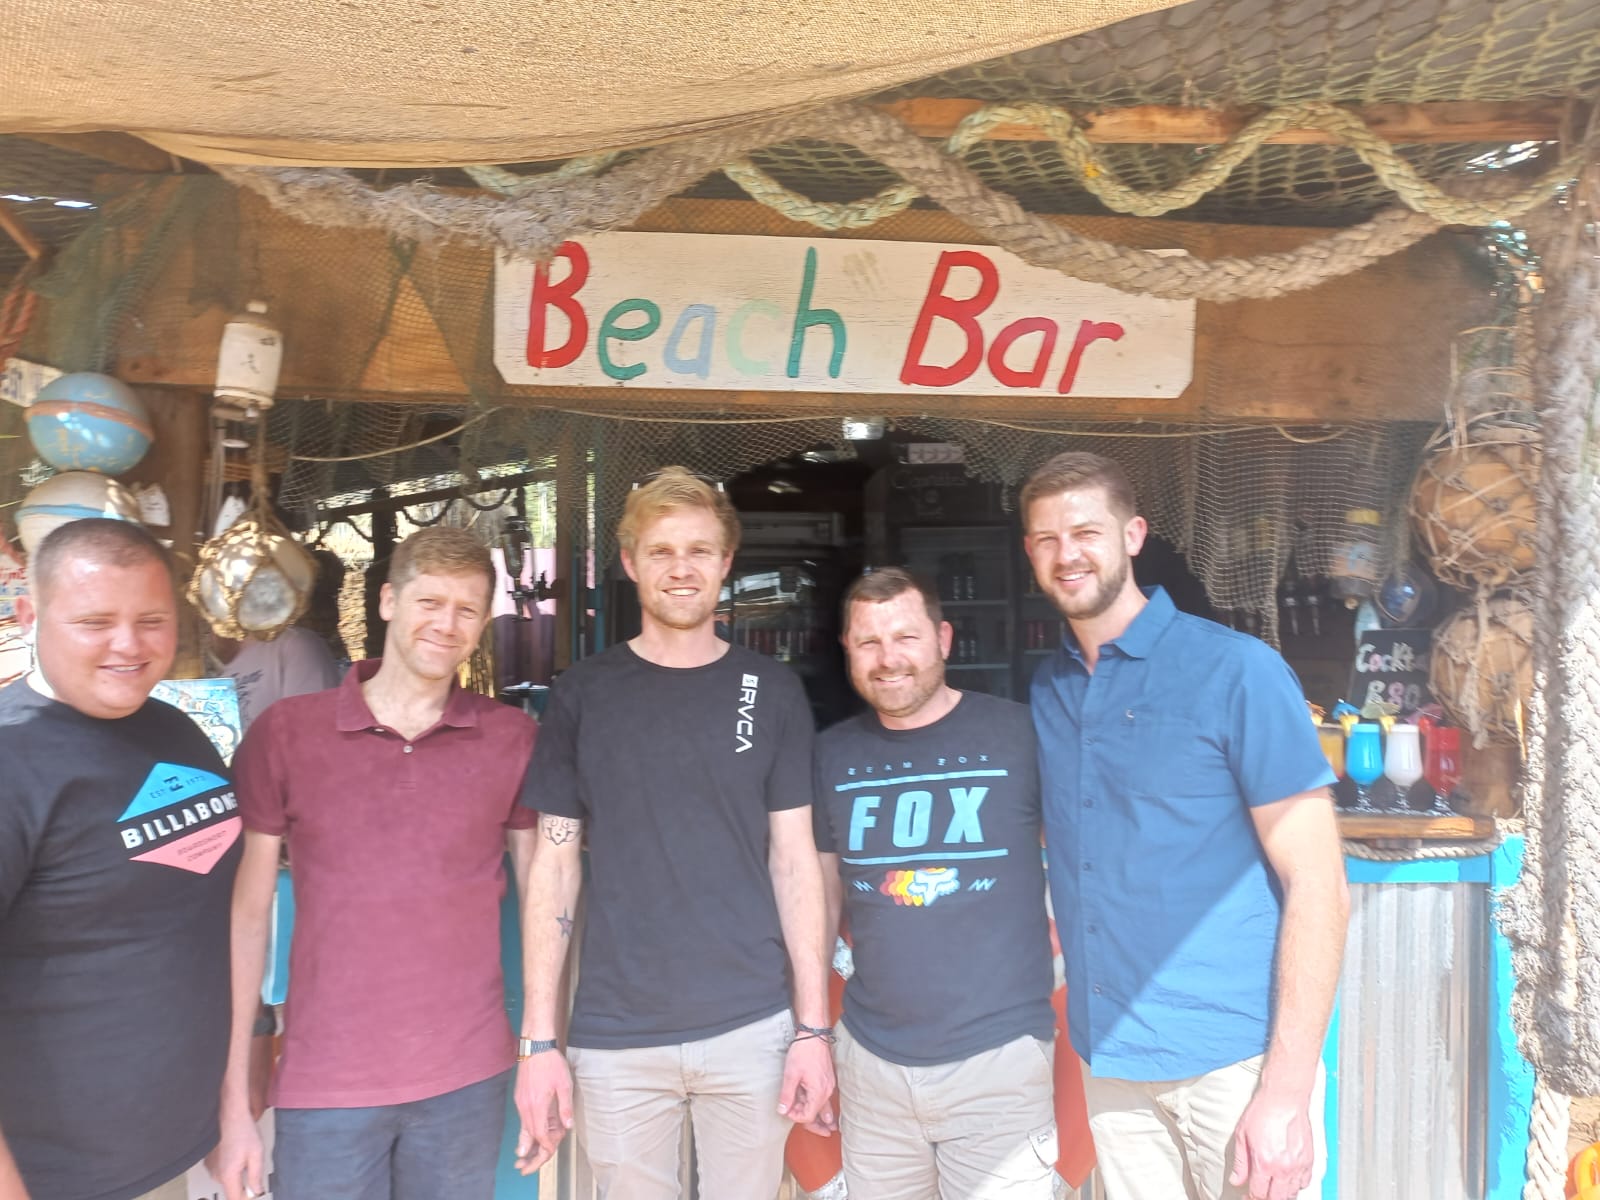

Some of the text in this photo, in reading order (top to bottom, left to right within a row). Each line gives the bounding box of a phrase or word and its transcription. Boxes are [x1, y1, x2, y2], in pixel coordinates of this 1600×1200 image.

[527, 241, 1125, 394] Beach Bar
[735, 687, 757, 753] RVCA
[120, 791, 238, 849] BILLABON
[848, 786, 990, 851] FOX
